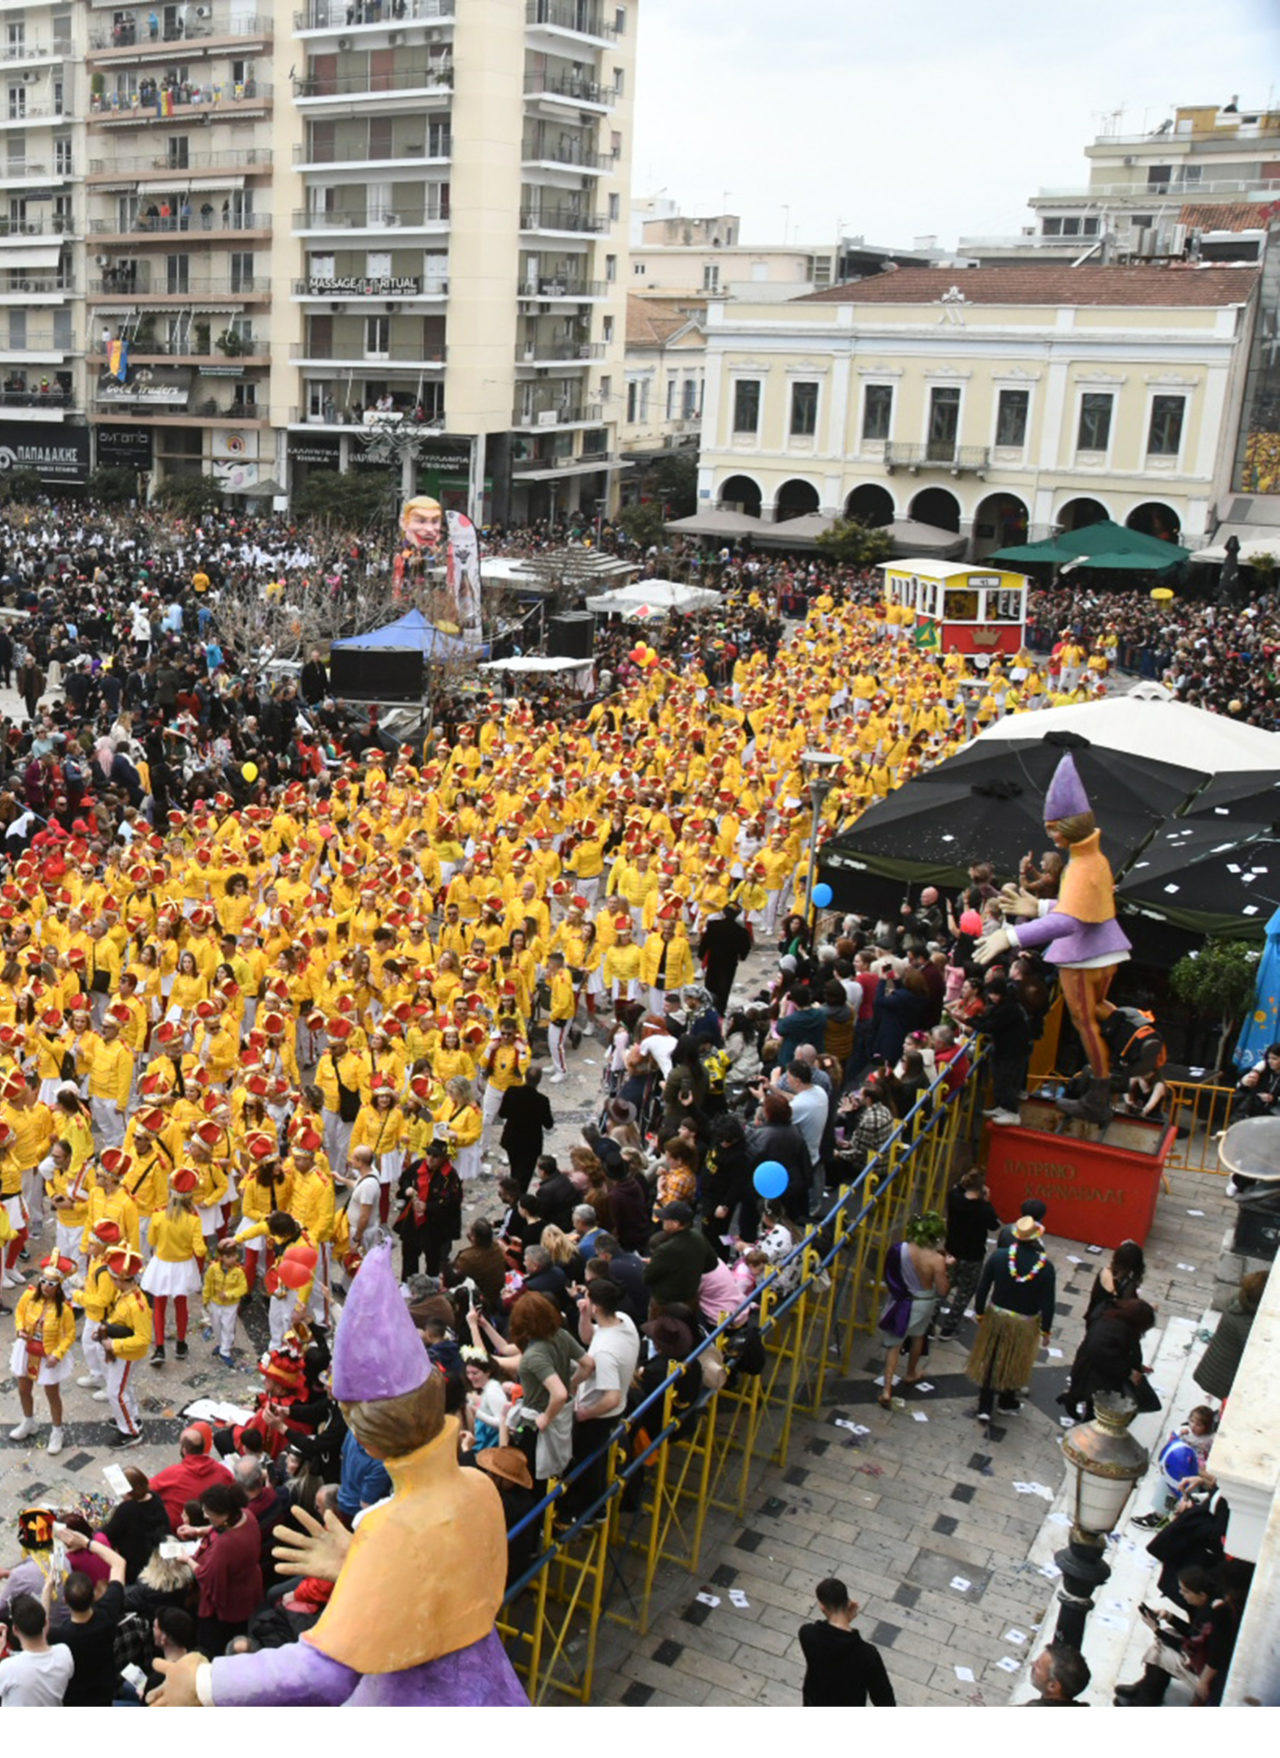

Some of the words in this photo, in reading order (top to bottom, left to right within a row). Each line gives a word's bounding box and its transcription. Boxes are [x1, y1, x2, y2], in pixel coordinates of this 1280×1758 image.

[309, 278, 356, 288] MASSAGE
[380, 278, 417, 288] RITUAL
[106, 383, 134, 395] Gold
[17, 446, 78, 462] ΠΑΠΑΔΑΚΗΣ
